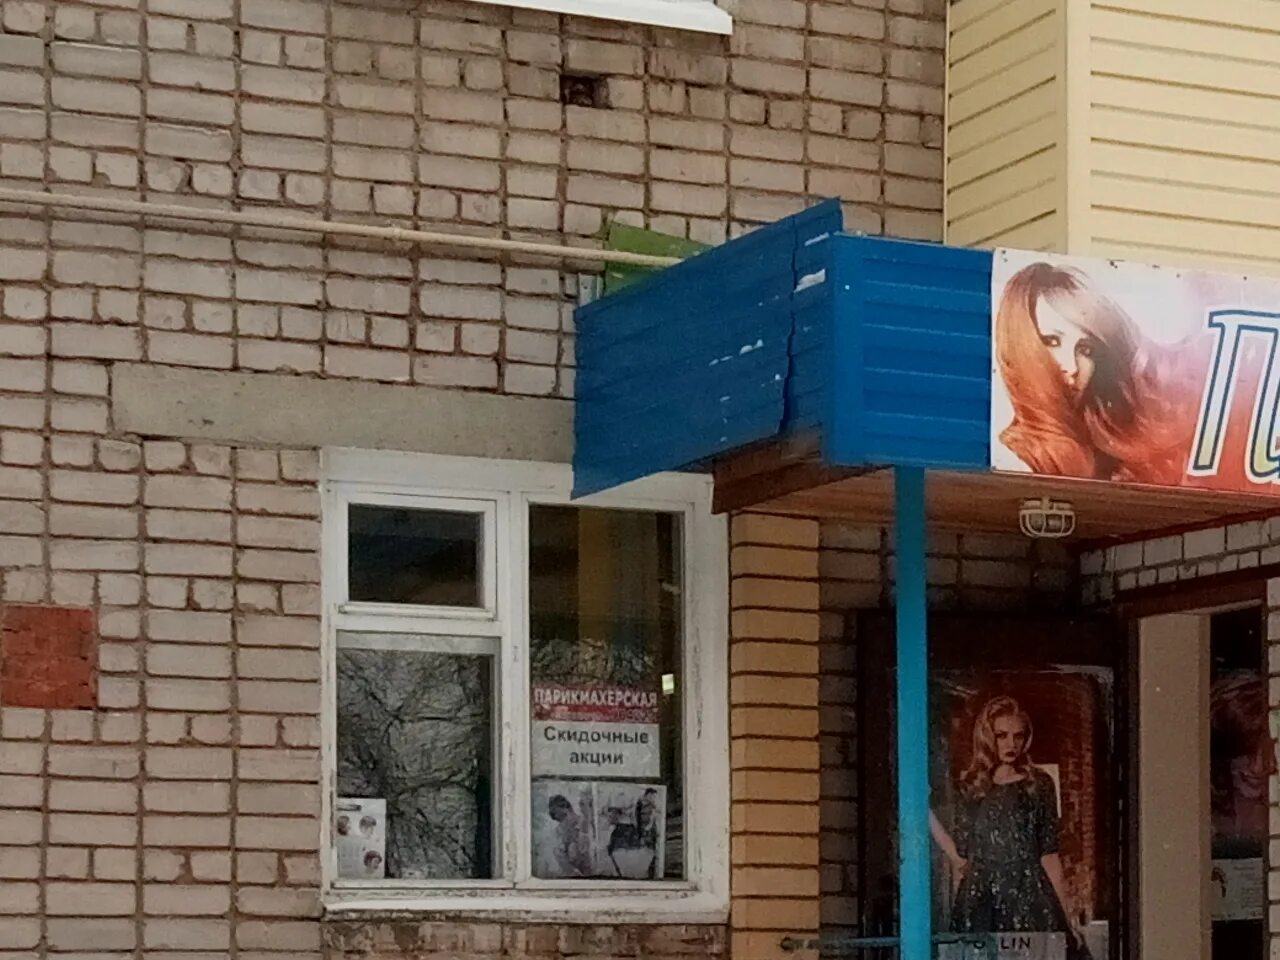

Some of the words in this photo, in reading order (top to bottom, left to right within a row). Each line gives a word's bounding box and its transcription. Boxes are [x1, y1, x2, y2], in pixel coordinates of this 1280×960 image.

[534, 687, 658, 707] ПАРИКМАХЕРСКАЯ
[543, 726, 649, 744] Скидочные
[569, 751, 624, 766] акции
